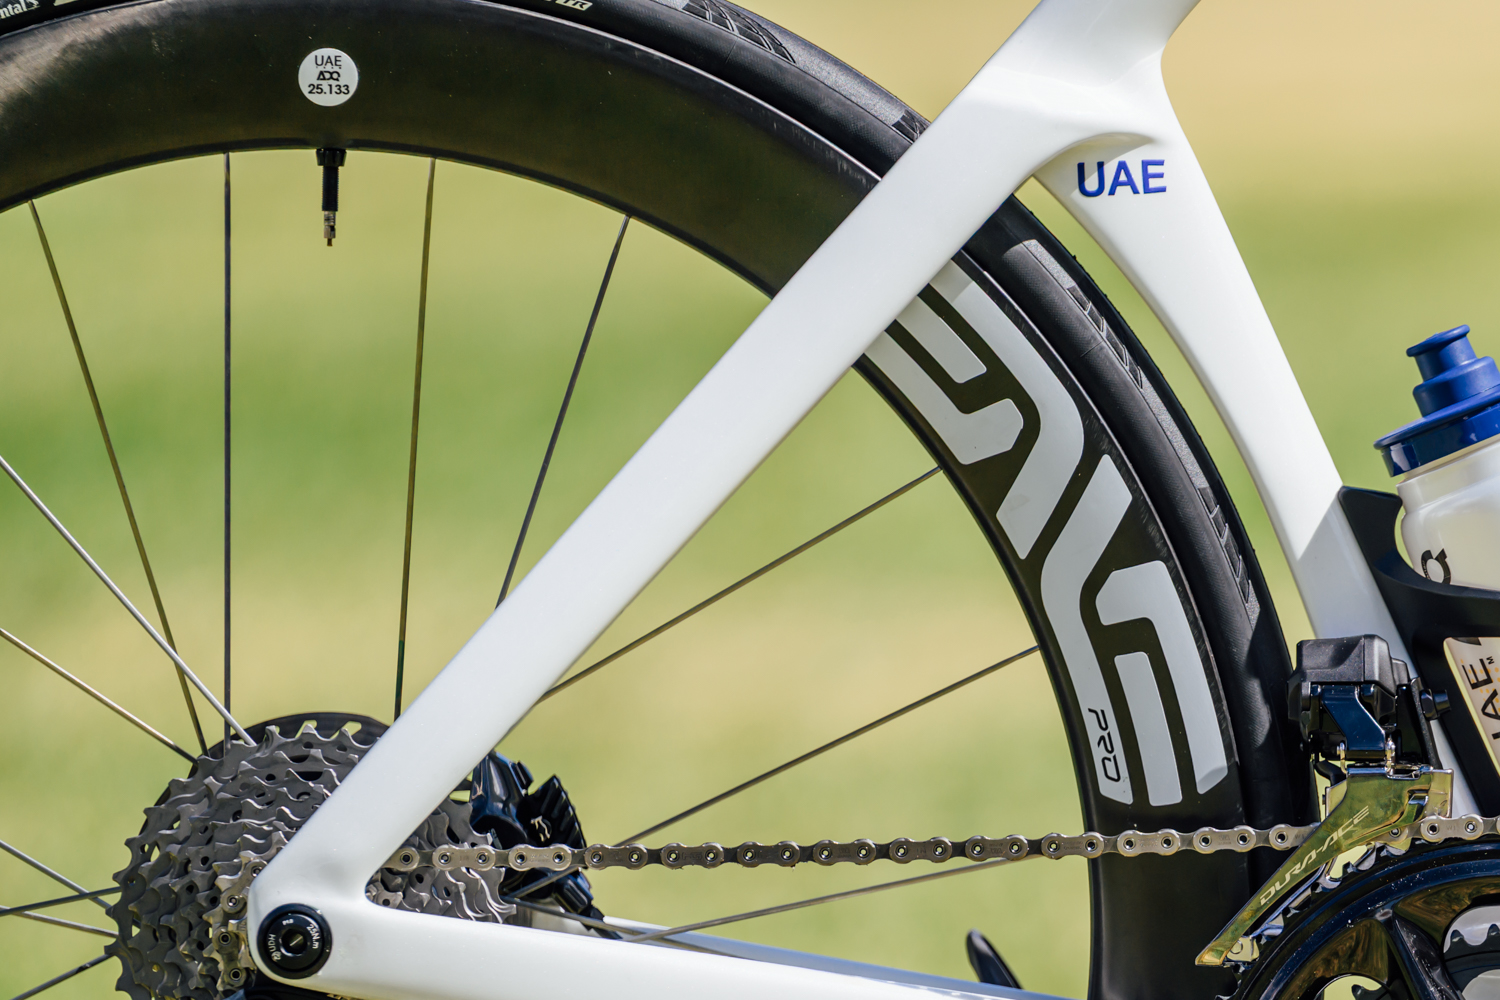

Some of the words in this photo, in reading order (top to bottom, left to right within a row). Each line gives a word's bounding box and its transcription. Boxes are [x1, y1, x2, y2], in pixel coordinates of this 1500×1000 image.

[314, 54, 342, 67] UAE
[307, 83, 350, 95] 25.133
[1077, 159, 1167, 197] UAE
[1087, 708, 1122, 783] PRO
[1259, 804, 1370, 906] DURA-ACE
